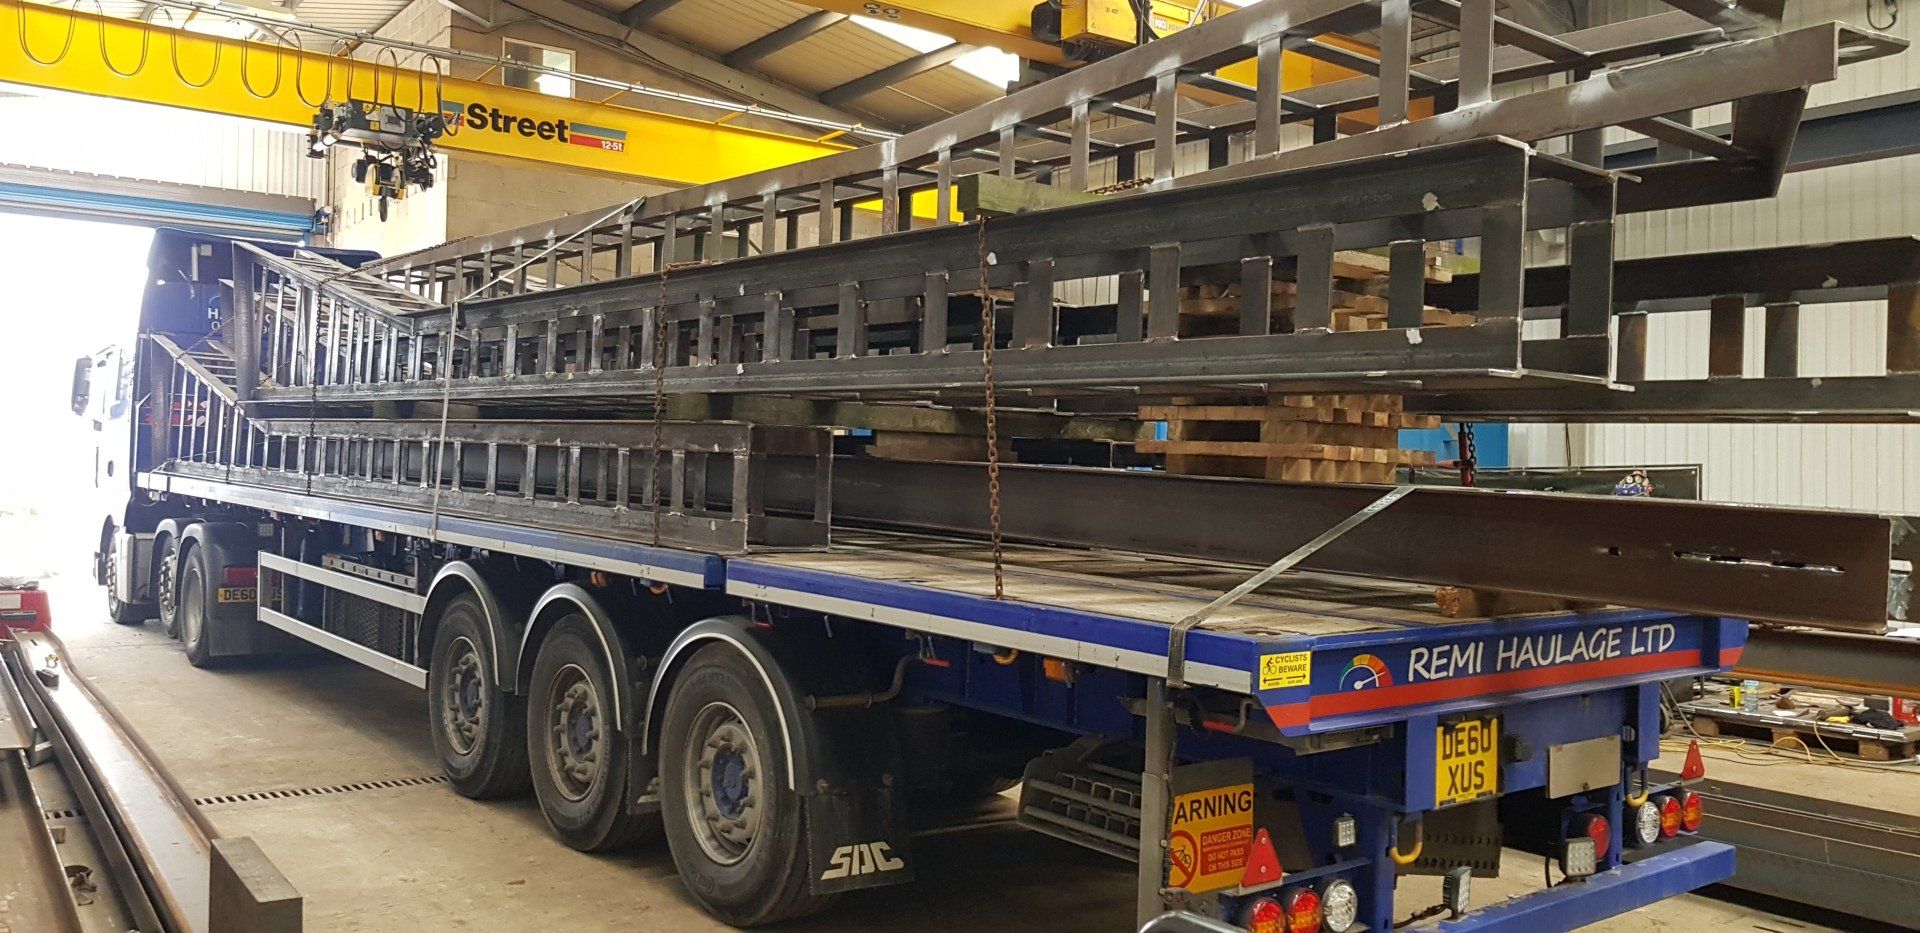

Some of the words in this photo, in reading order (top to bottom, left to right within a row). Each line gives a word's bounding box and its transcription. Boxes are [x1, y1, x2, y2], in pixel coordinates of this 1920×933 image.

[466, 103, 568, 143] Street
[224, 589, 257, 600] DE60
[1275, 654, 1307, 664] CYCLISTS
[1408, 641, 1484, 681] REMI
[1496, 627, 1622, 671] HAULAGE
[1631, 623, 1676, 655] LTD
[1278, 664, 1307, 673] BEWARE
[1442, 724, 1491, 760] DE60
[1447, 760, 1485, 796] XUS
[1173, 790, 1251, 825] ARNING
[1202, 831, 1231, 846] DANGER
[1232, 828, 1251, 840] ZONE
[821, 841, 904, 880] SDC
[1208, 852, 1217, 862] DO
[1217, 849, 1229, 860] NOT
[1218, 860, 1230, 870] THIS
